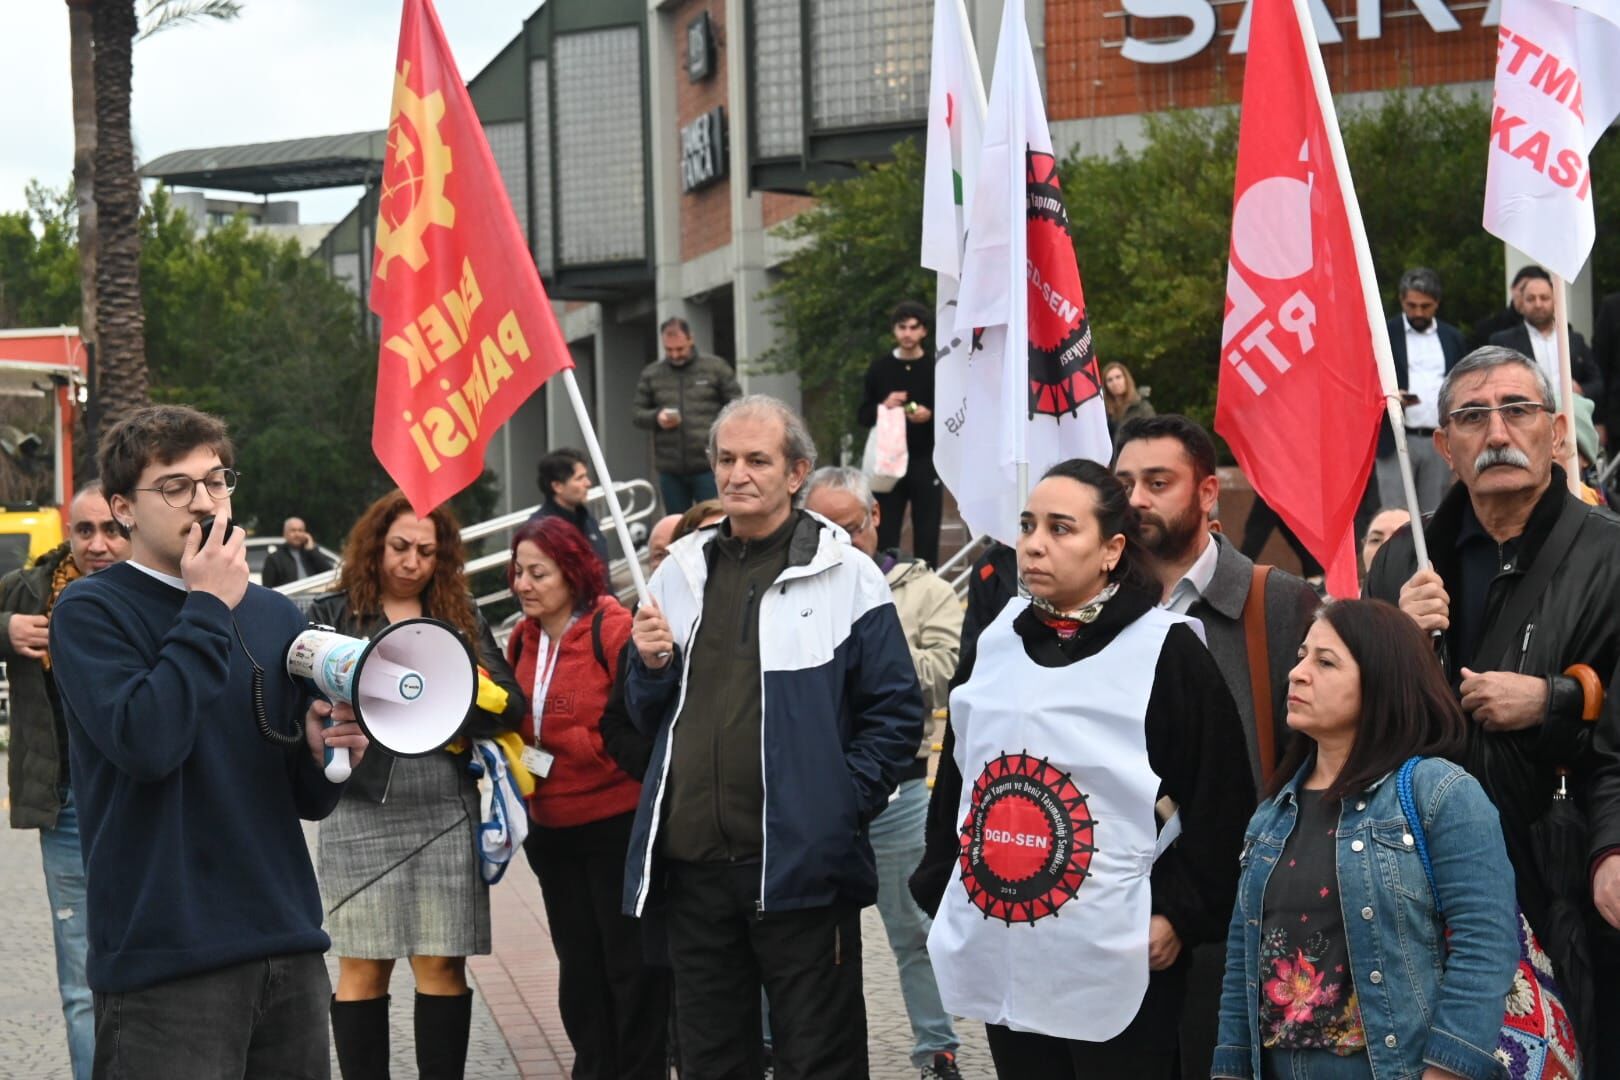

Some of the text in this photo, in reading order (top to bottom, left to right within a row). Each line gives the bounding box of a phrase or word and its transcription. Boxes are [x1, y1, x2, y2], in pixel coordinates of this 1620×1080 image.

[1490, 106, 1591, 201] KASI
[1027, 258, 1079, 324] GD-SEN
[1014, 782, 1022, 791] ve
[1023, 781, 1042, 798] Deniz
[985, 828, 1047, 849] DGD-SEN
